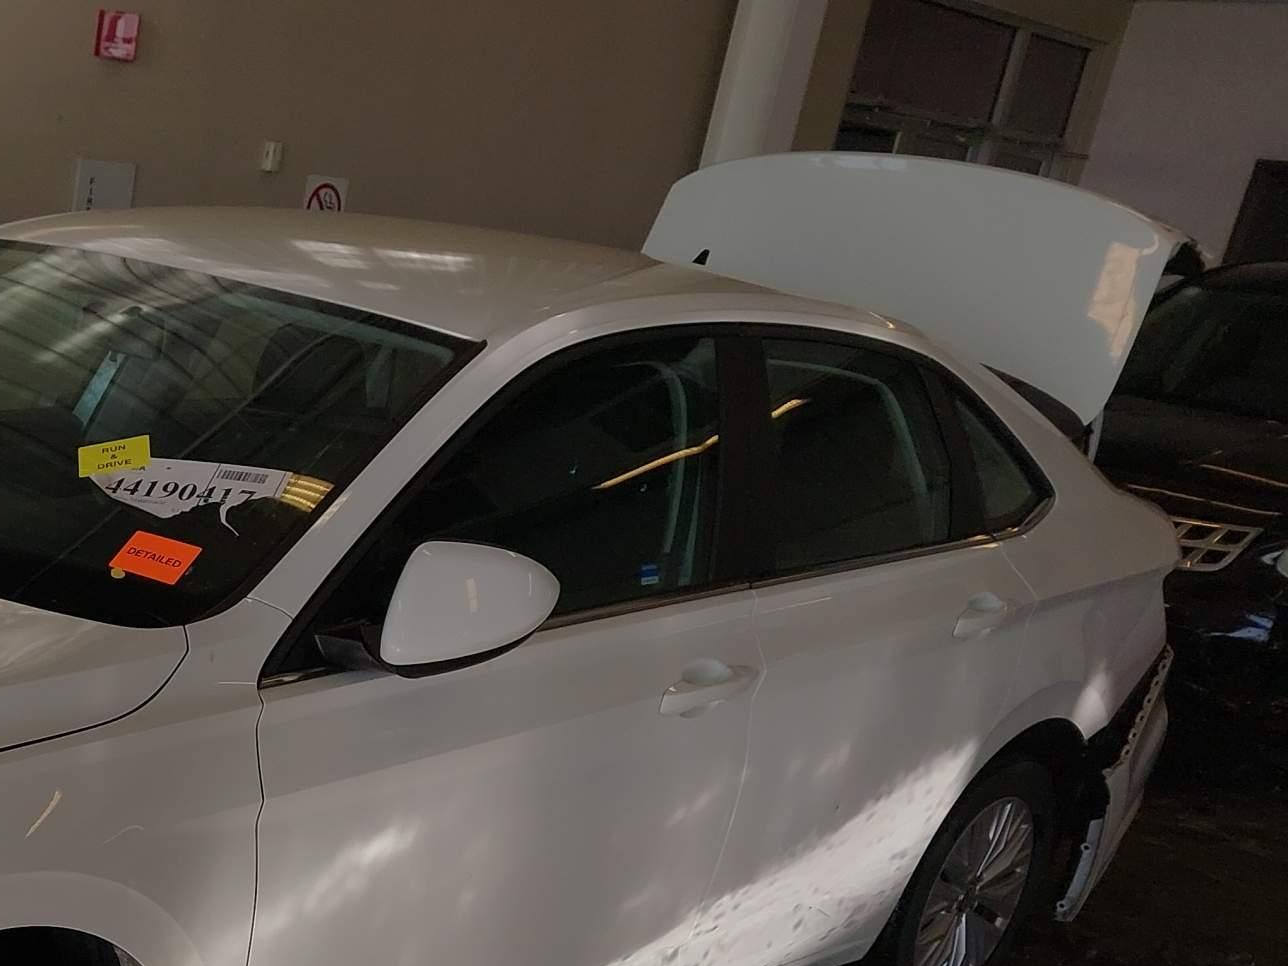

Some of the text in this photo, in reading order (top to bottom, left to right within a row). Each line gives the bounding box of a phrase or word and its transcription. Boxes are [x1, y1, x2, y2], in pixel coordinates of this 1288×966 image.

[101, 444, 126, 454] RUN
[97, 459, 132, 470] DRIVE
[126, 546, 182, 568] DETAILED
